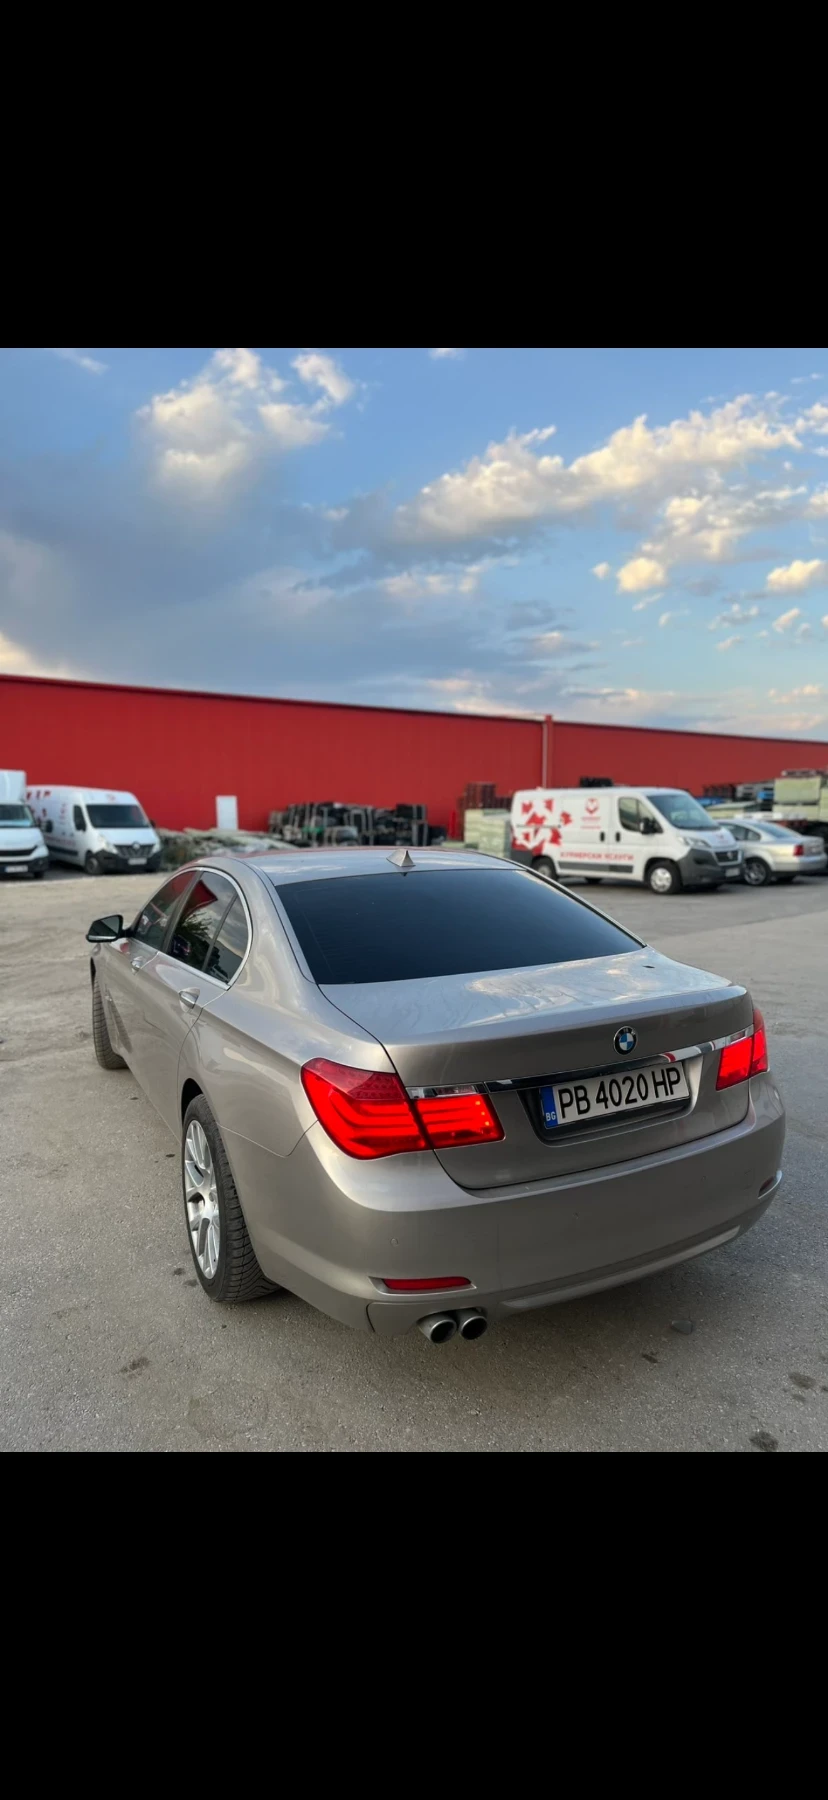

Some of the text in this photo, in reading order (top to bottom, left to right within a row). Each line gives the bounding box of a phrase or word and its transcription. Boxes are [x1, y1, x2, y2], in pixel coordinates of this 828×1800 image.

[557, 1067, 681, 1119] PB 4020 HP
[545, 1112, 556, 1121] BG
